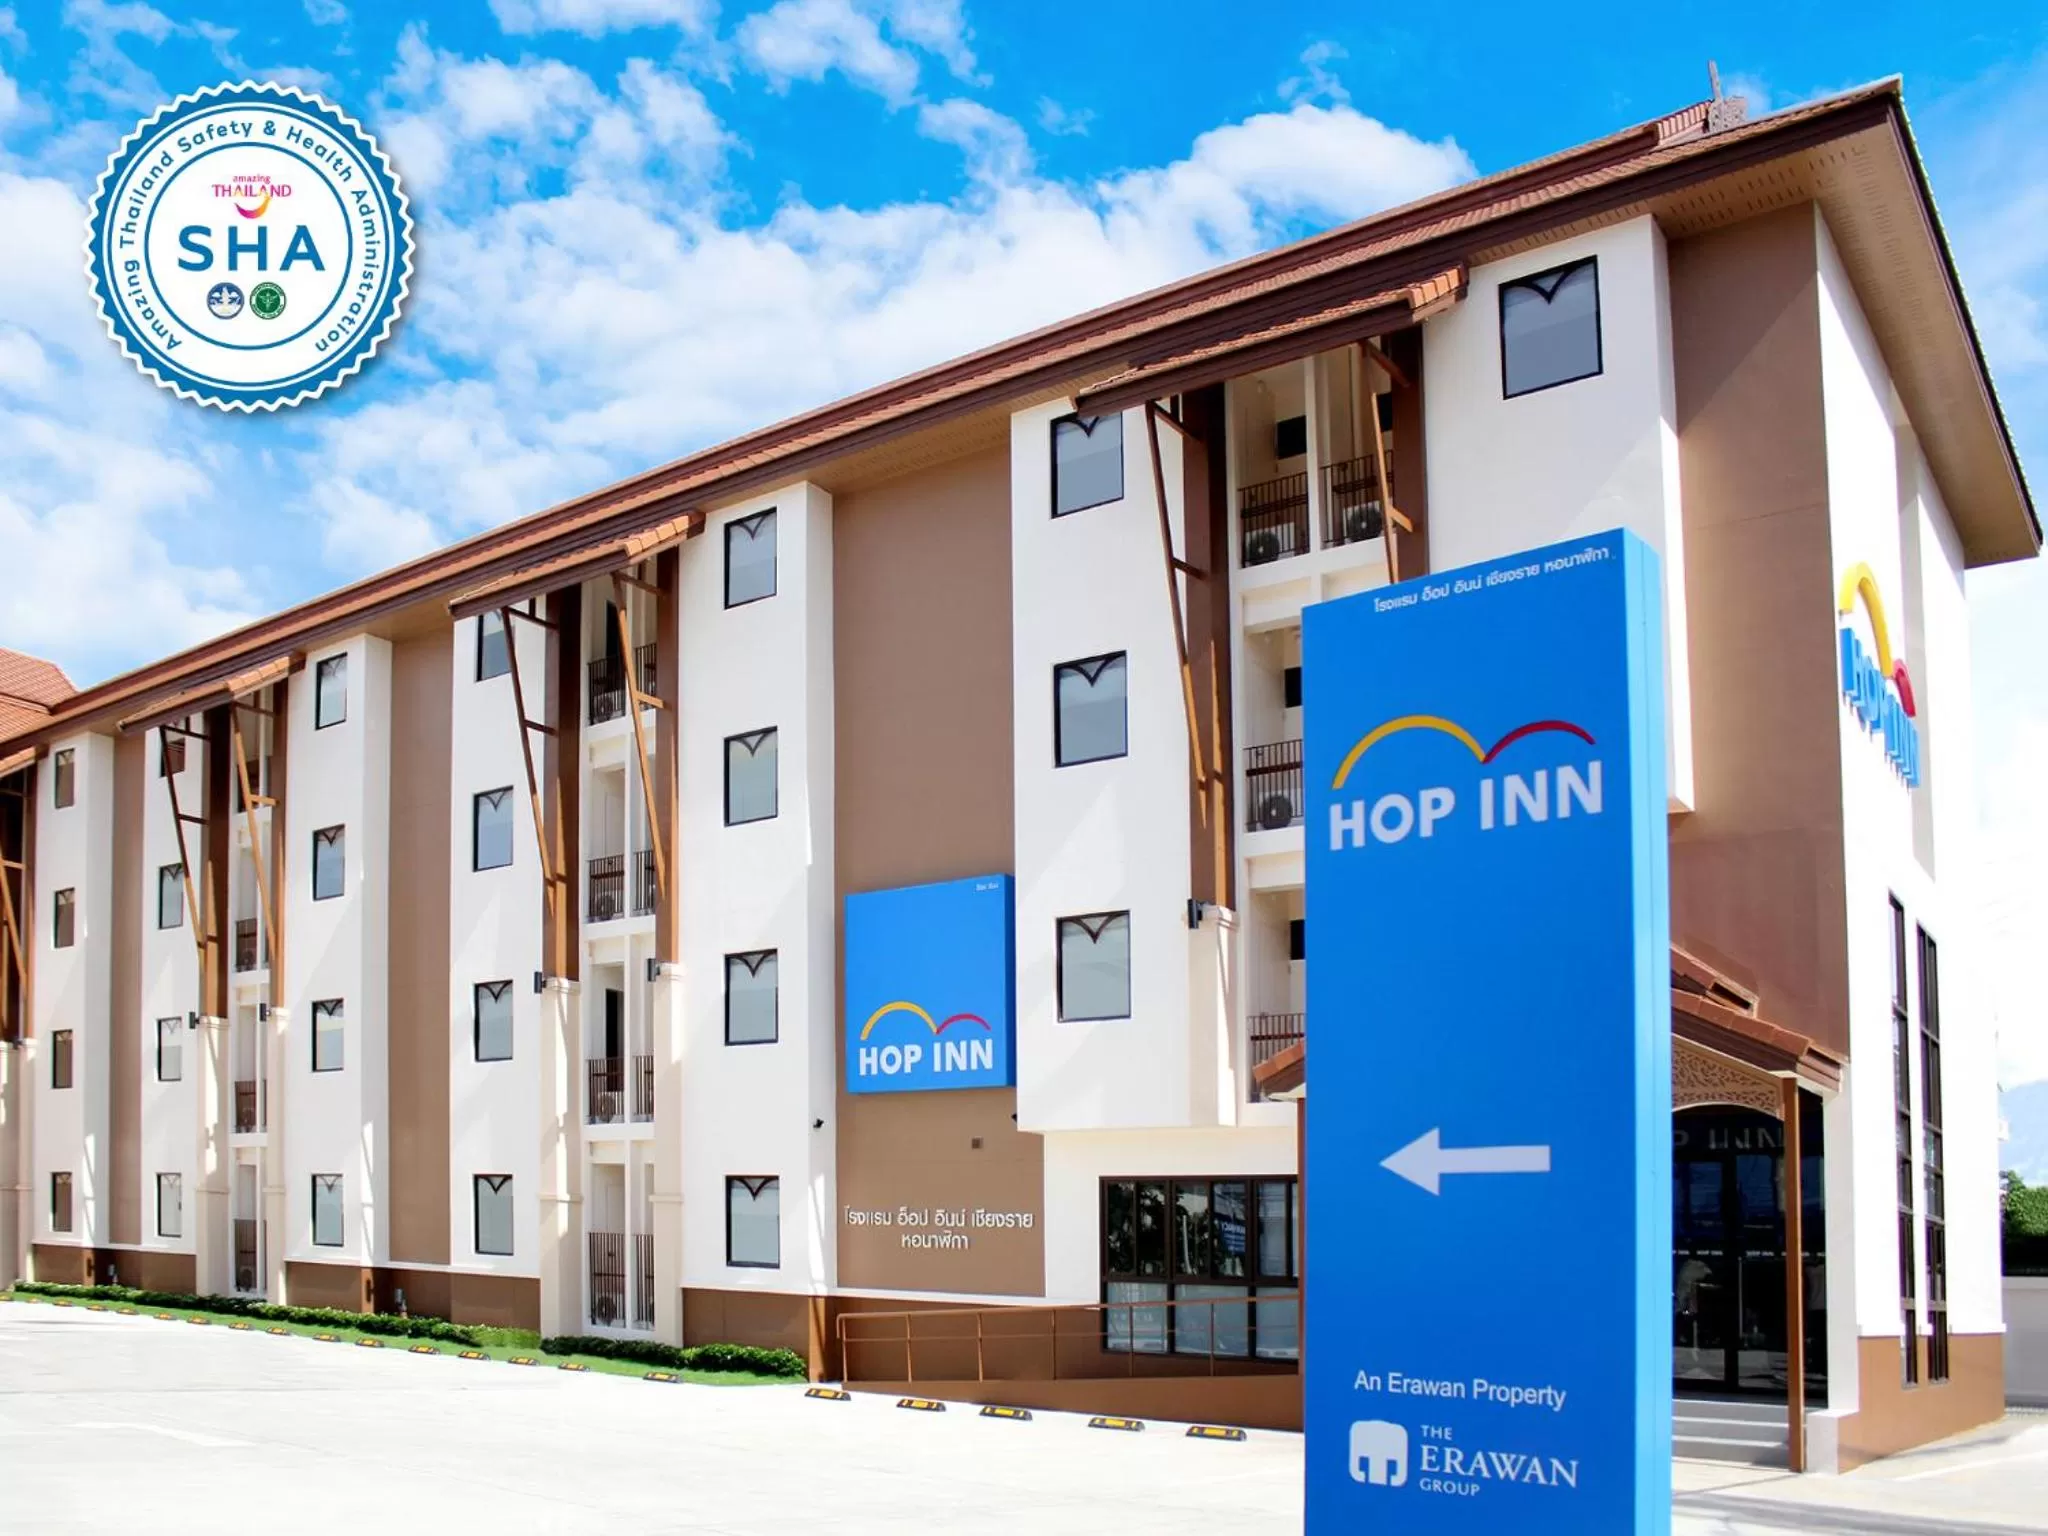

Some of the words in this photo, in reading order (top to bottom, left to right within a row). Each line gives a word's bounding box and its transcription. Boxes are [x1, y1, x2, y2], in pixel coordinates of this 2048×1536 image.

[1329, 786, 1456, 851] HOP
[1480, 760, 1603, 831] INN
[858, 1044, 923, 1077] HOP
[933, 1038, 994, 1072] INN
[844, 1204, 891, 1226] โรงแรม
[971, 1208, 1033, 1228] เชียงราย
[1354, 1370, 1381, 1391] An
[1388, 1372, 1465, 1399] Erawan
[1472, 1379, 1567, 1412] Property
[1421, 1425, 1452, 1441] THE
[1420, 1444, 1579, 1488] ERAWAN
[1420, 1478, 1480, 1496] GROUP
